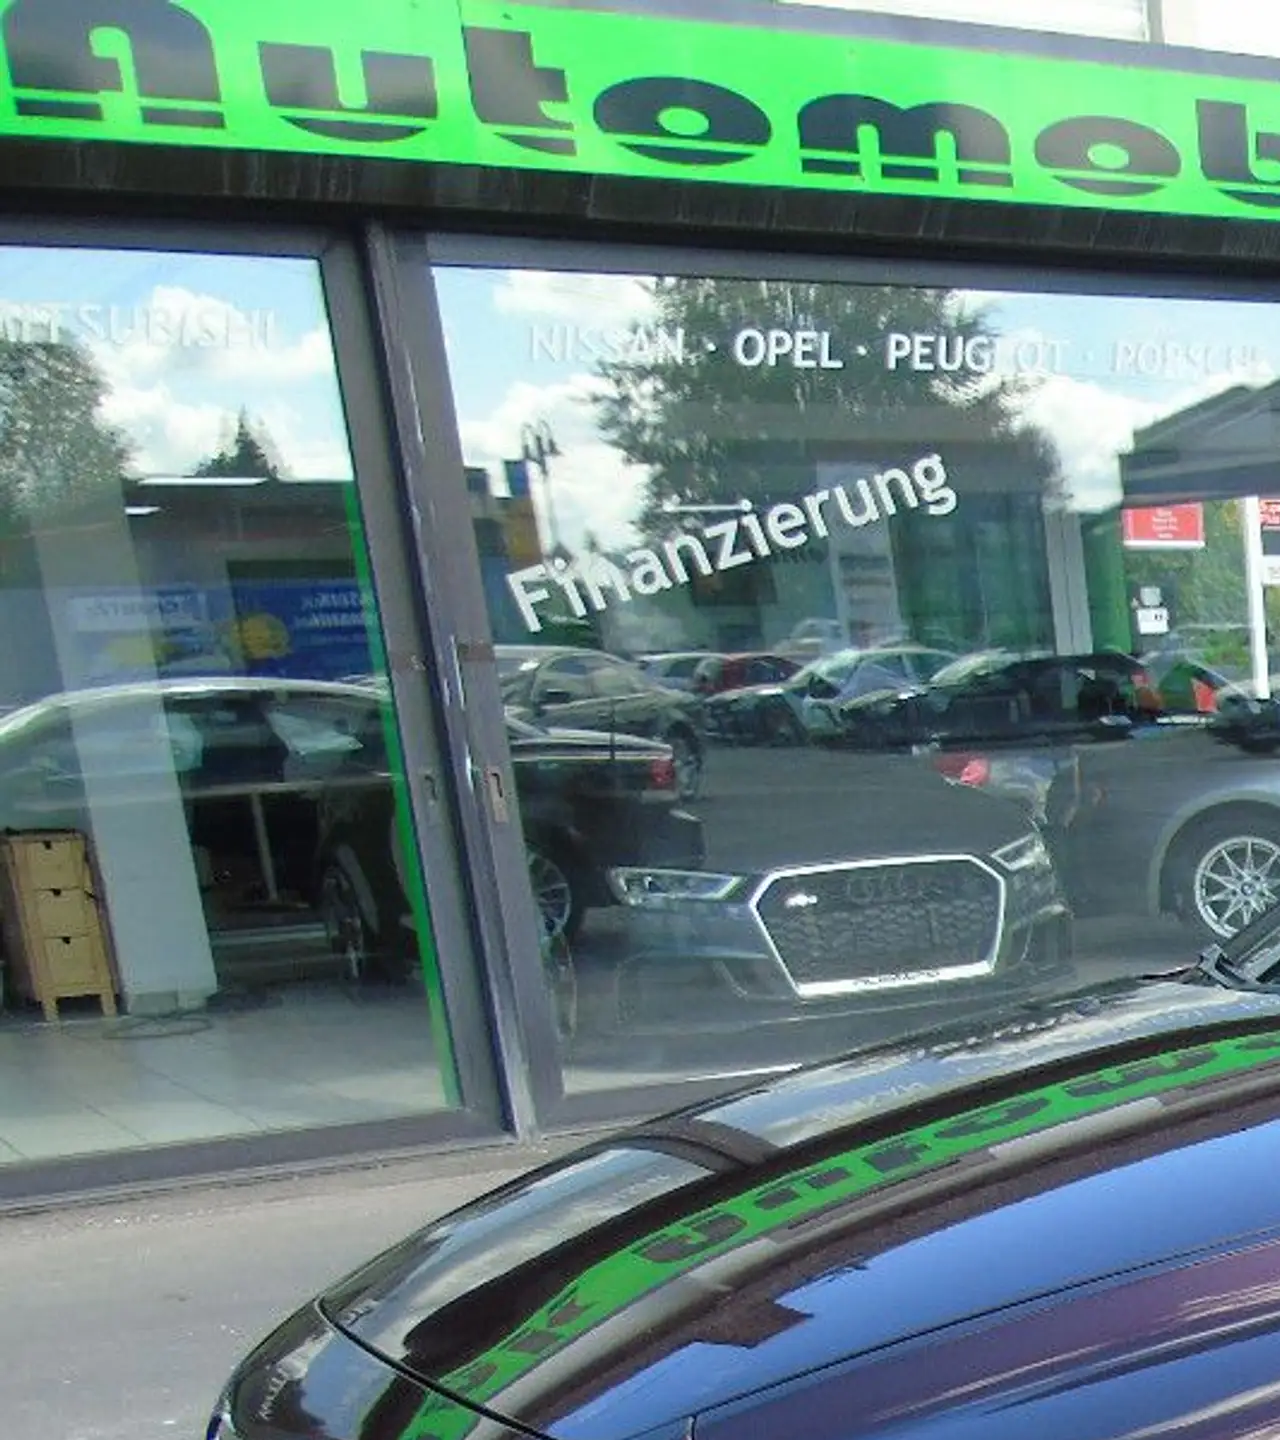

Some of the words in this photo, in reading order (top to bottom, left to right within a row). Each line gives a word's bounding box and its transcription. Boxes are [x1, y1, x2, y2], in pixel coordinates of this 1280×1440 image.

[528, 326, 686, 367] NISSAN
[734, 327, 844, 369] OPEL
[506, 450, 960, 633] Finanzierung
